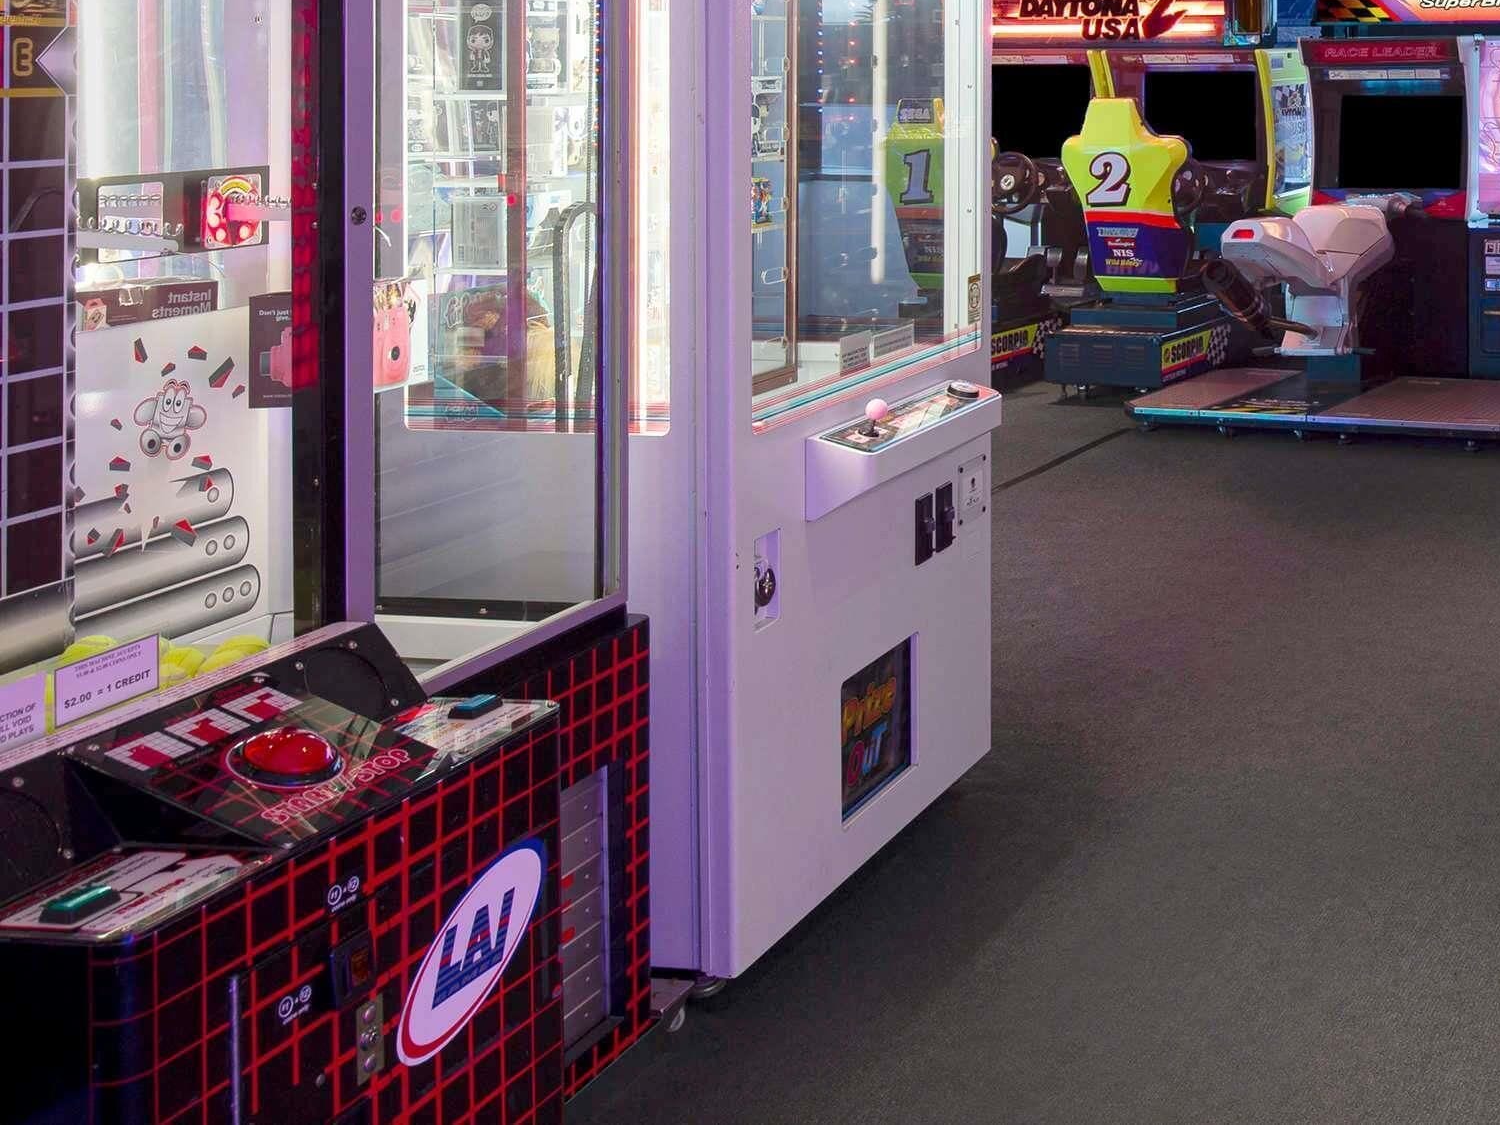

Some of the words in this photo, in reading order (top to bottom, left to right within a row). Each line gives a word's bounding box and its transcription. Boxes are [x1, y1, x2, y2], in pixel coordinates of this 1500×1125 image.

[1081, 18, 1141, 40] USA
[1324, 47, 1369, 58] RACE
[1372, 44, 1439, 59] LEADER
[900, 149, 934, 204] 1
[1086, 151, 1132, 207] 2
[1112, 249, 1134, 257] NIS
[64, 691, 92, 709] $2.00
[106, 683, 112, 693] 1
[115, 669, 151, 690] CREDIT
[25, 702, 36, 713] OF
[841, 677, 897, 747] Prize
[12, 715, 32, 727] VOID
[8, 725, 34, 740] PLAYS
[432, 886, 516, 1011] LAI
